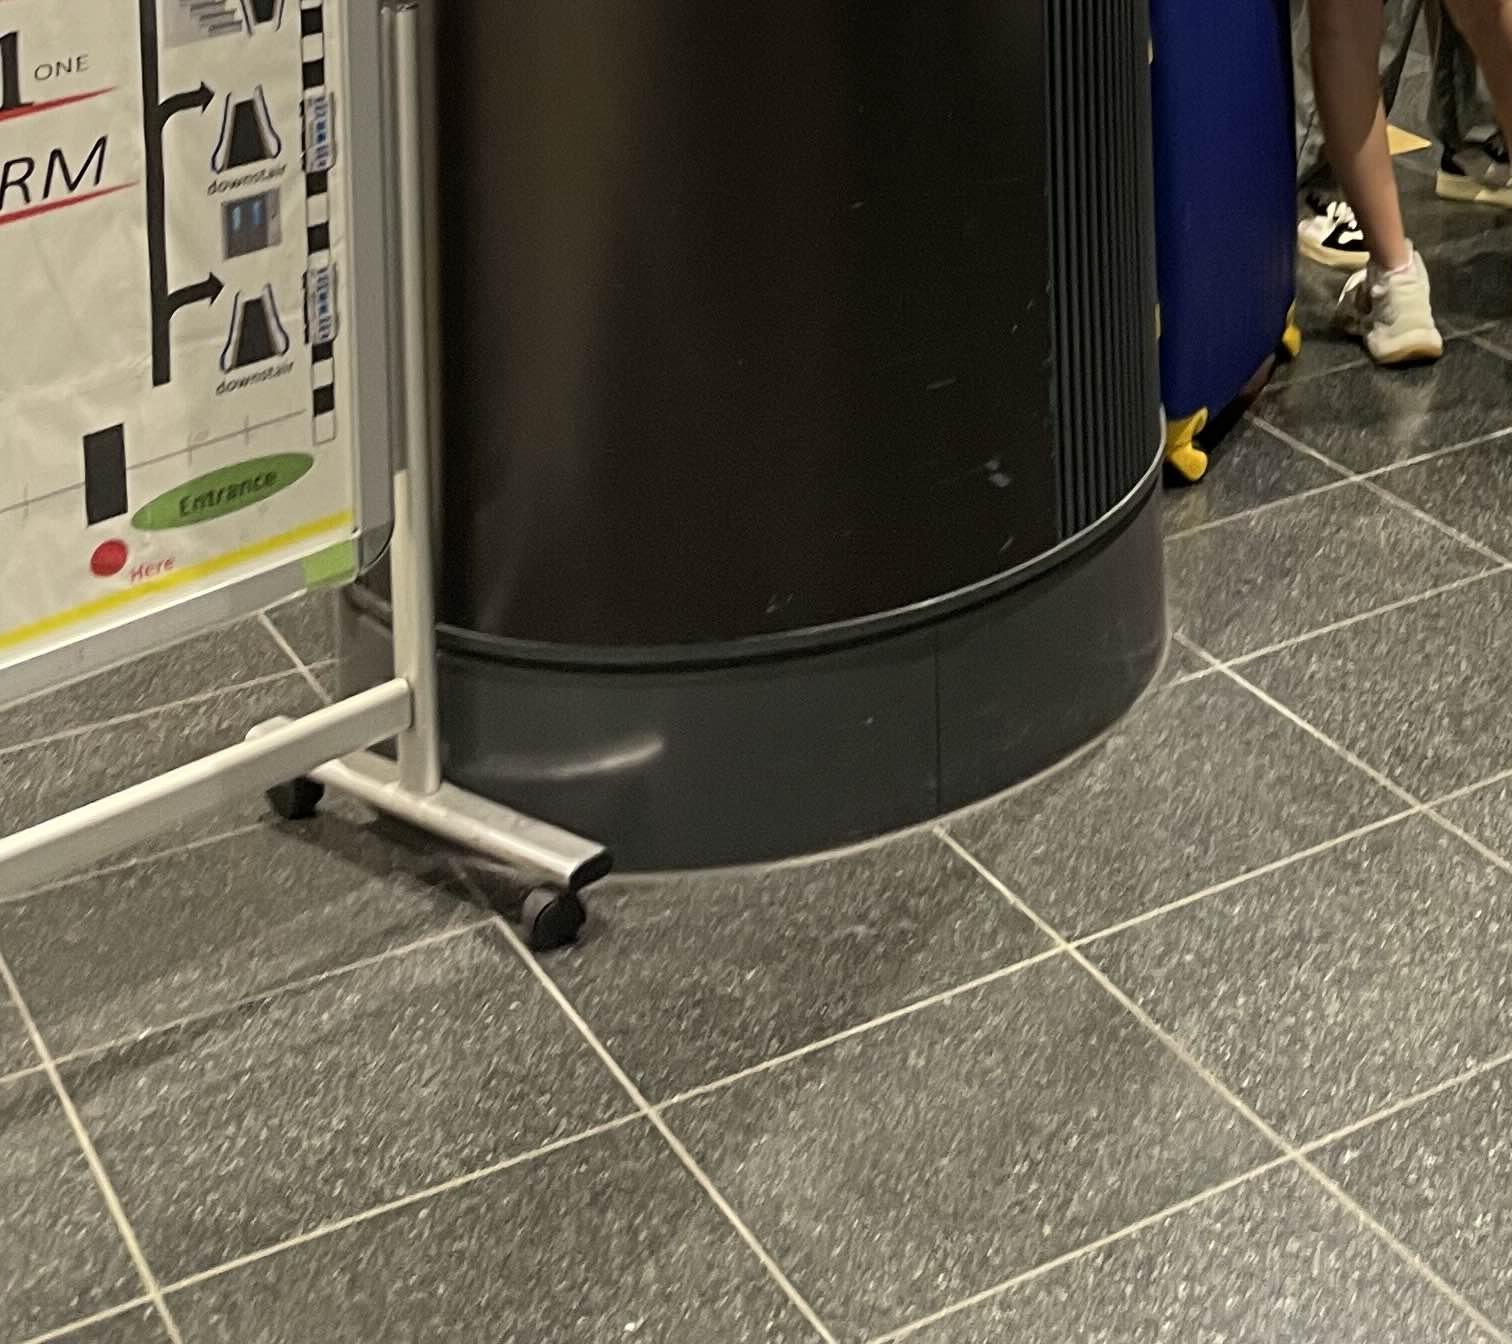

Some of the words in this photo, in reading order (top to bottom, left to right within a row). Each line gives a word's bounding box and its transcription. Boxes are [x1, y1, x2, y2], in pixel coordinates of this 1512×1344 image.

[33, 53, 90, 82] ONE
[206, 164, 287, 198] downstair
[214, 360, 294, 397] downstair
[178, 470, 279, 518] Entrance
[129, 555, 176, 585] Here
